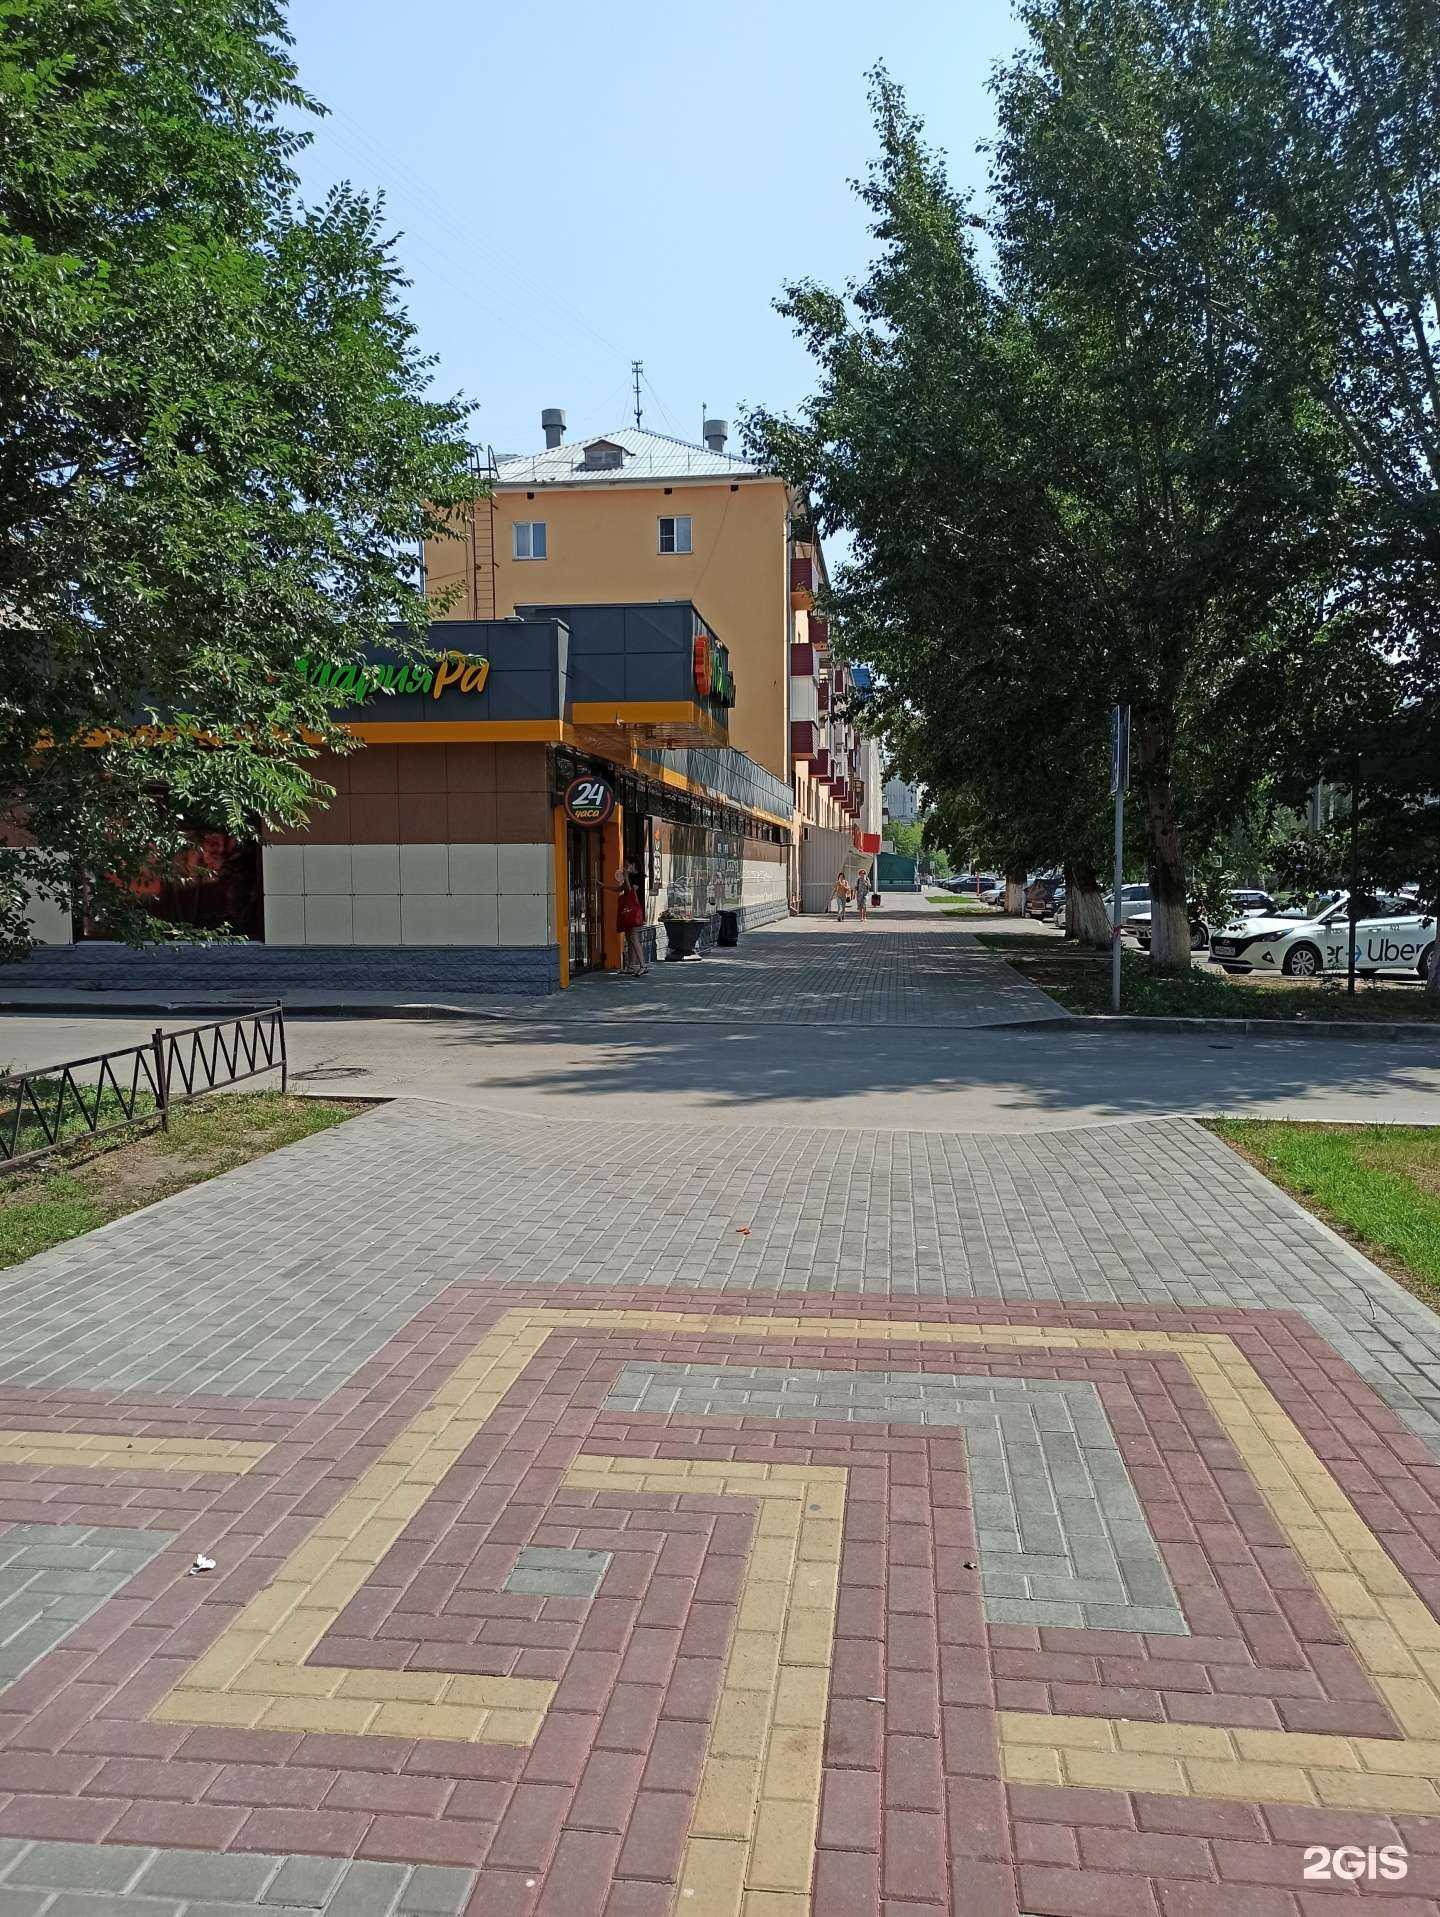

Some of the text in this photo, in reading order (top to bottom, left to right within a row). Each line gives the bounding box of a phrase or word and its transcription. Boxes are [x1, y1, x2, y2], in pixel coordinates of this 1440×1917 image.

[571, 783, 604, 805] 24
[575, 810, 600, 818] часа
[1368, 938, 1424, 961] Uber
